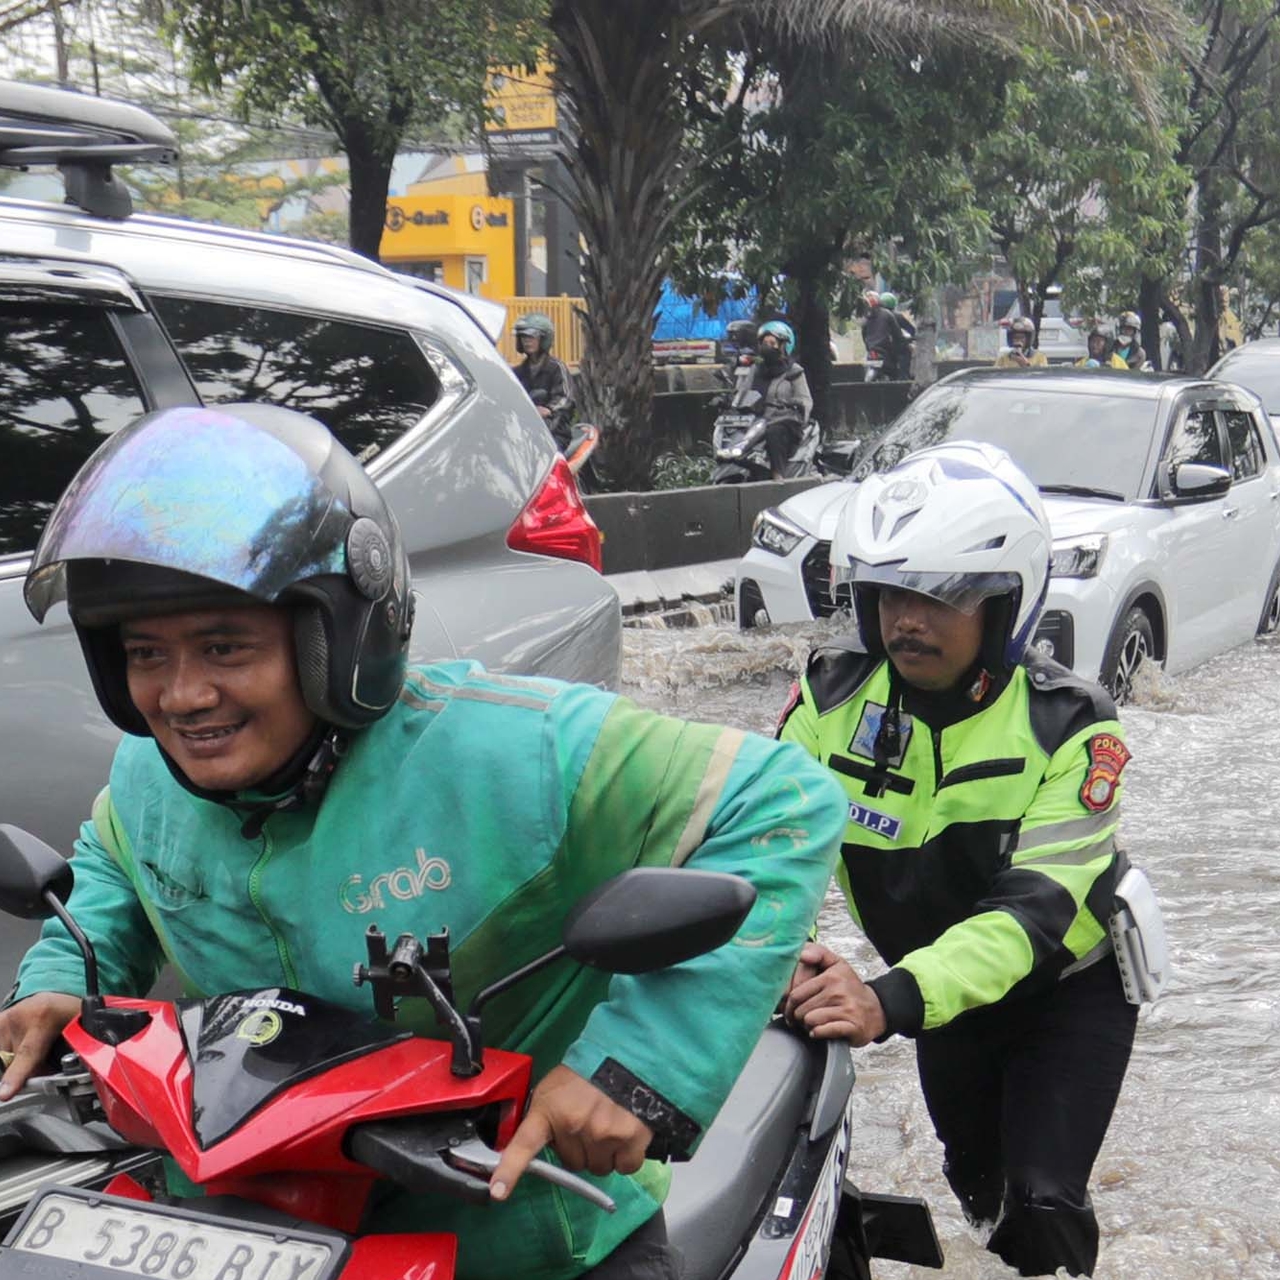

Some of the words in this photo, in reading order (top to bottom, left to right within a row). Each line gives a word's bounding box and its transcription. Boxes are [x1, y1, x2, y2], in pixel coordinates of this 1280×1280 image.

[340, 848, 451, 914] Grab
[241, 998, 305, 1016] HONDA
[27, 1207, 66, 1249] B
[85, 1219, 208, 1280] 5386
